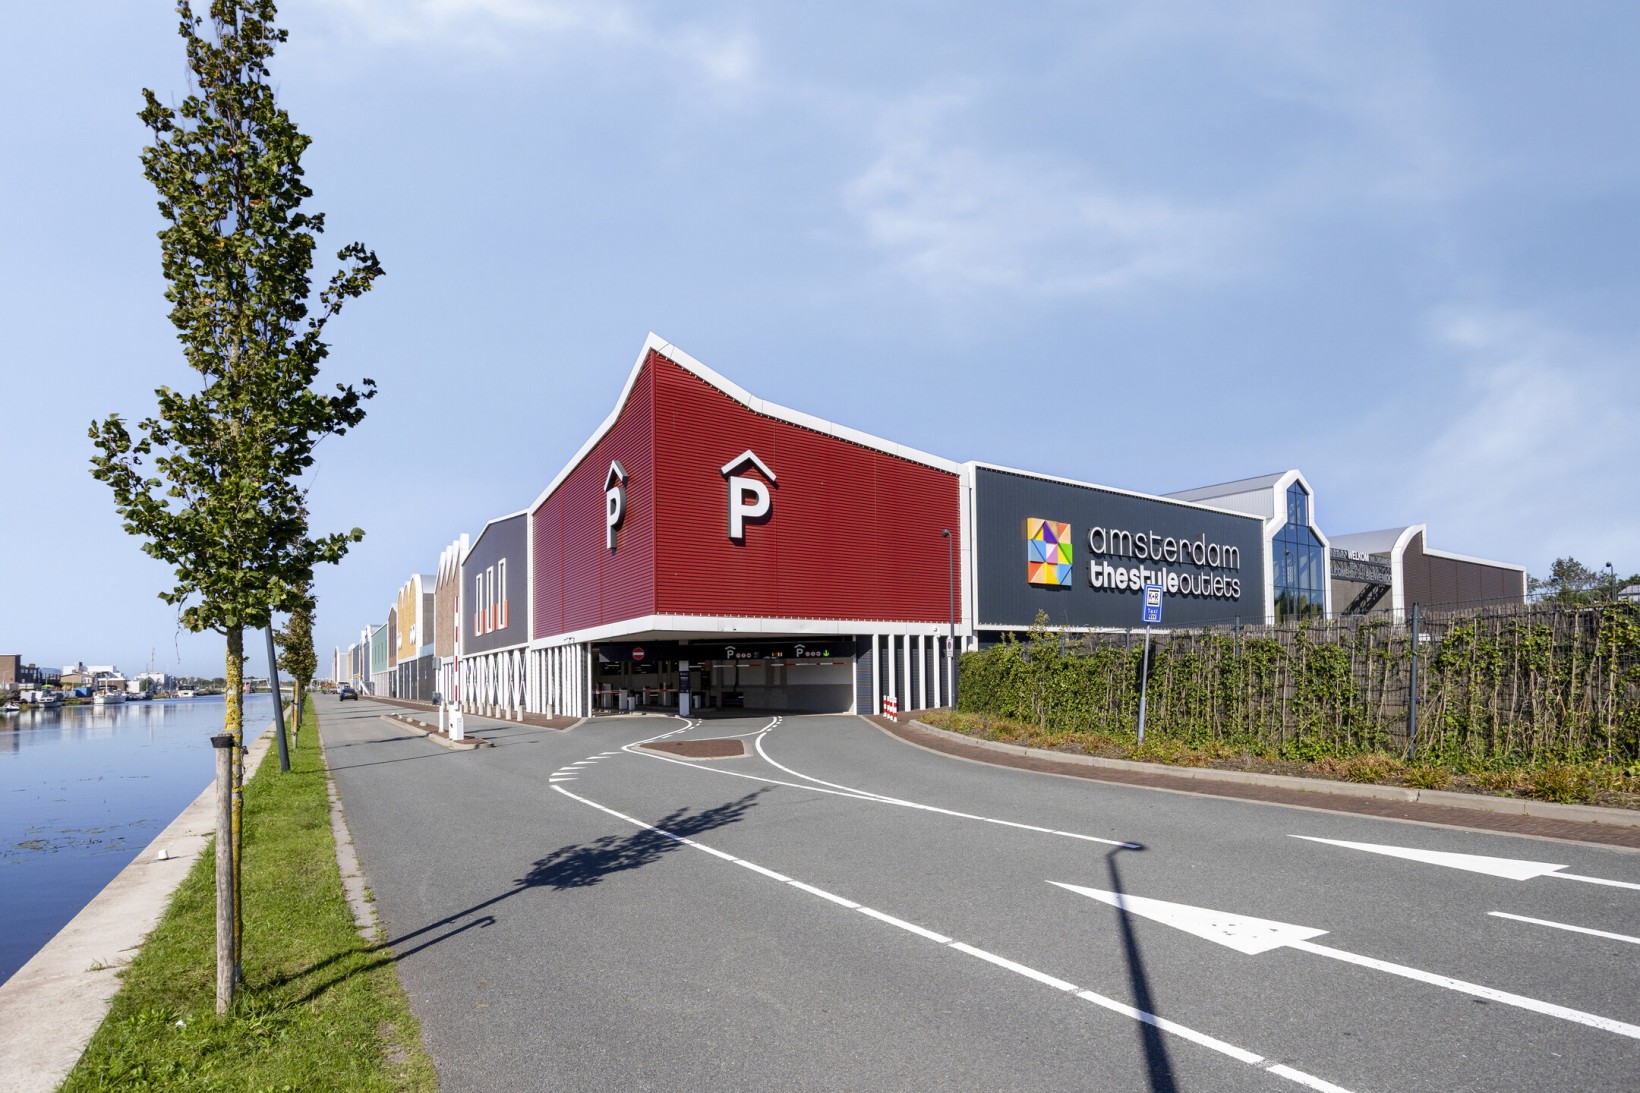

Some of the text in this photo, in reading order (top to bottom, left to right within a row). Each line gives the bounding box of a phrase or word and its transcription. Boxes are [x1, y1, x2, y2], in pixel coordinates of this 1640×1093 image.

[606, 486, 626, 549] P
[728, 476, 771, 539] P
[1089, 527, 1240, 569] amsterdam
[1348, 550, 1370, 562] WELKOM
[727, 650, 734, 659] P
[796, 648, 803, 657] P
